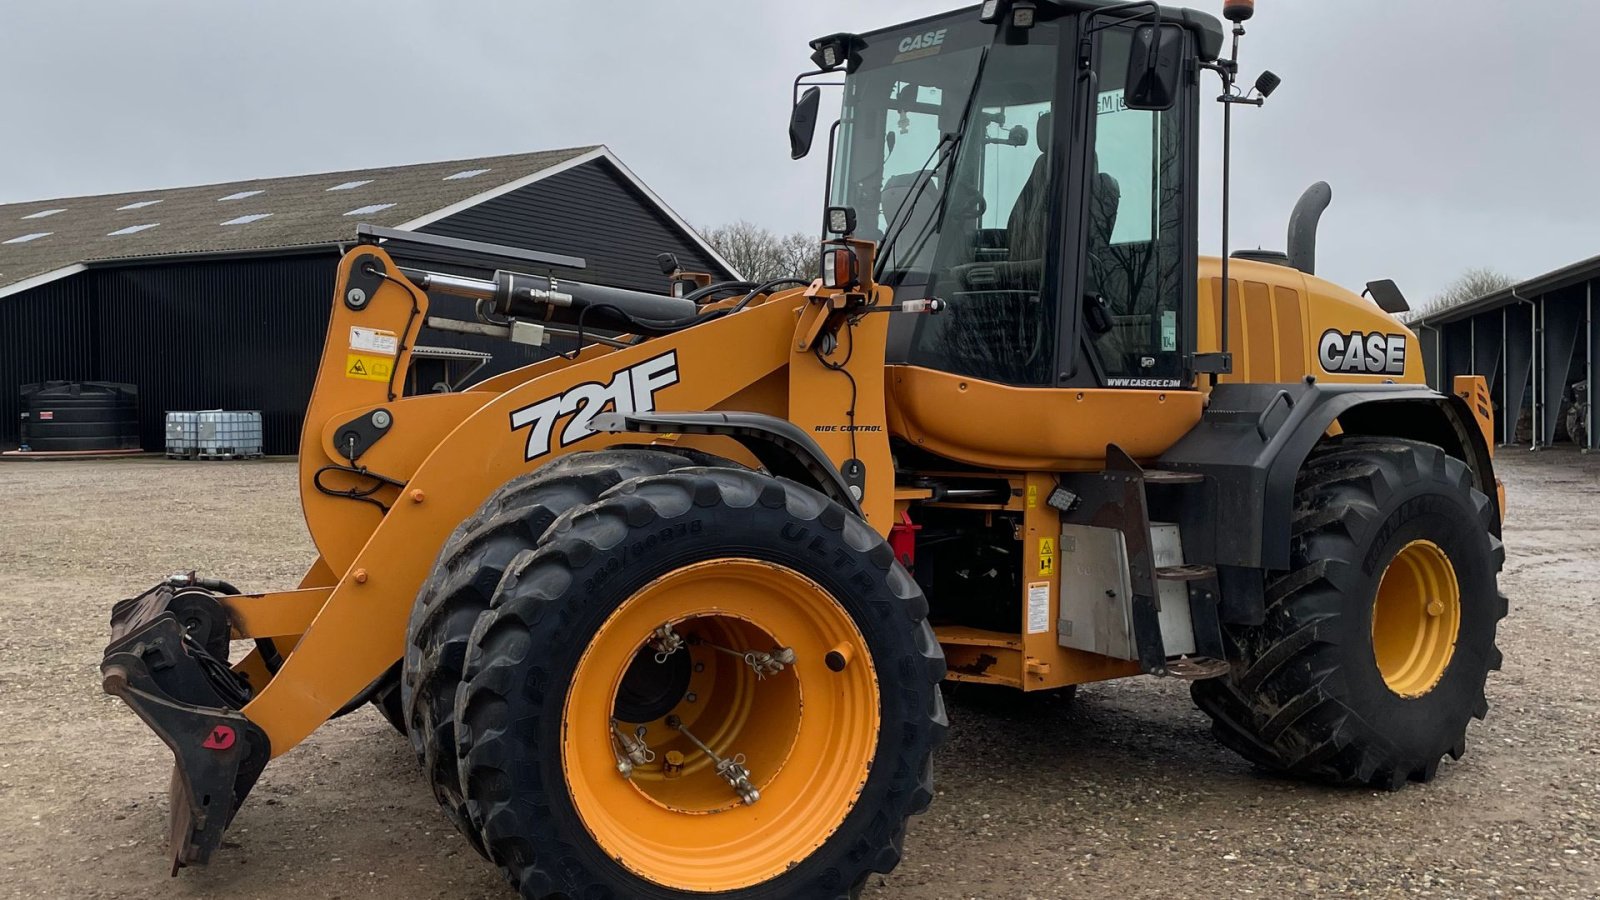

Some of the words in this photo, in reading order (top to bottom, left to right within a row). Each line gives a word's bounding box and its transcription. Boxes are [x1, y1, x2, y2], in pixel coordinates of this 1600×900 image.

[898, 28, 948, 53] CASE
[1318, 329, 1406, 375] CASE
[1107, 378, 1181, 388] WWW.CASECE.COM
[510, 349, 680, 462] 721F
